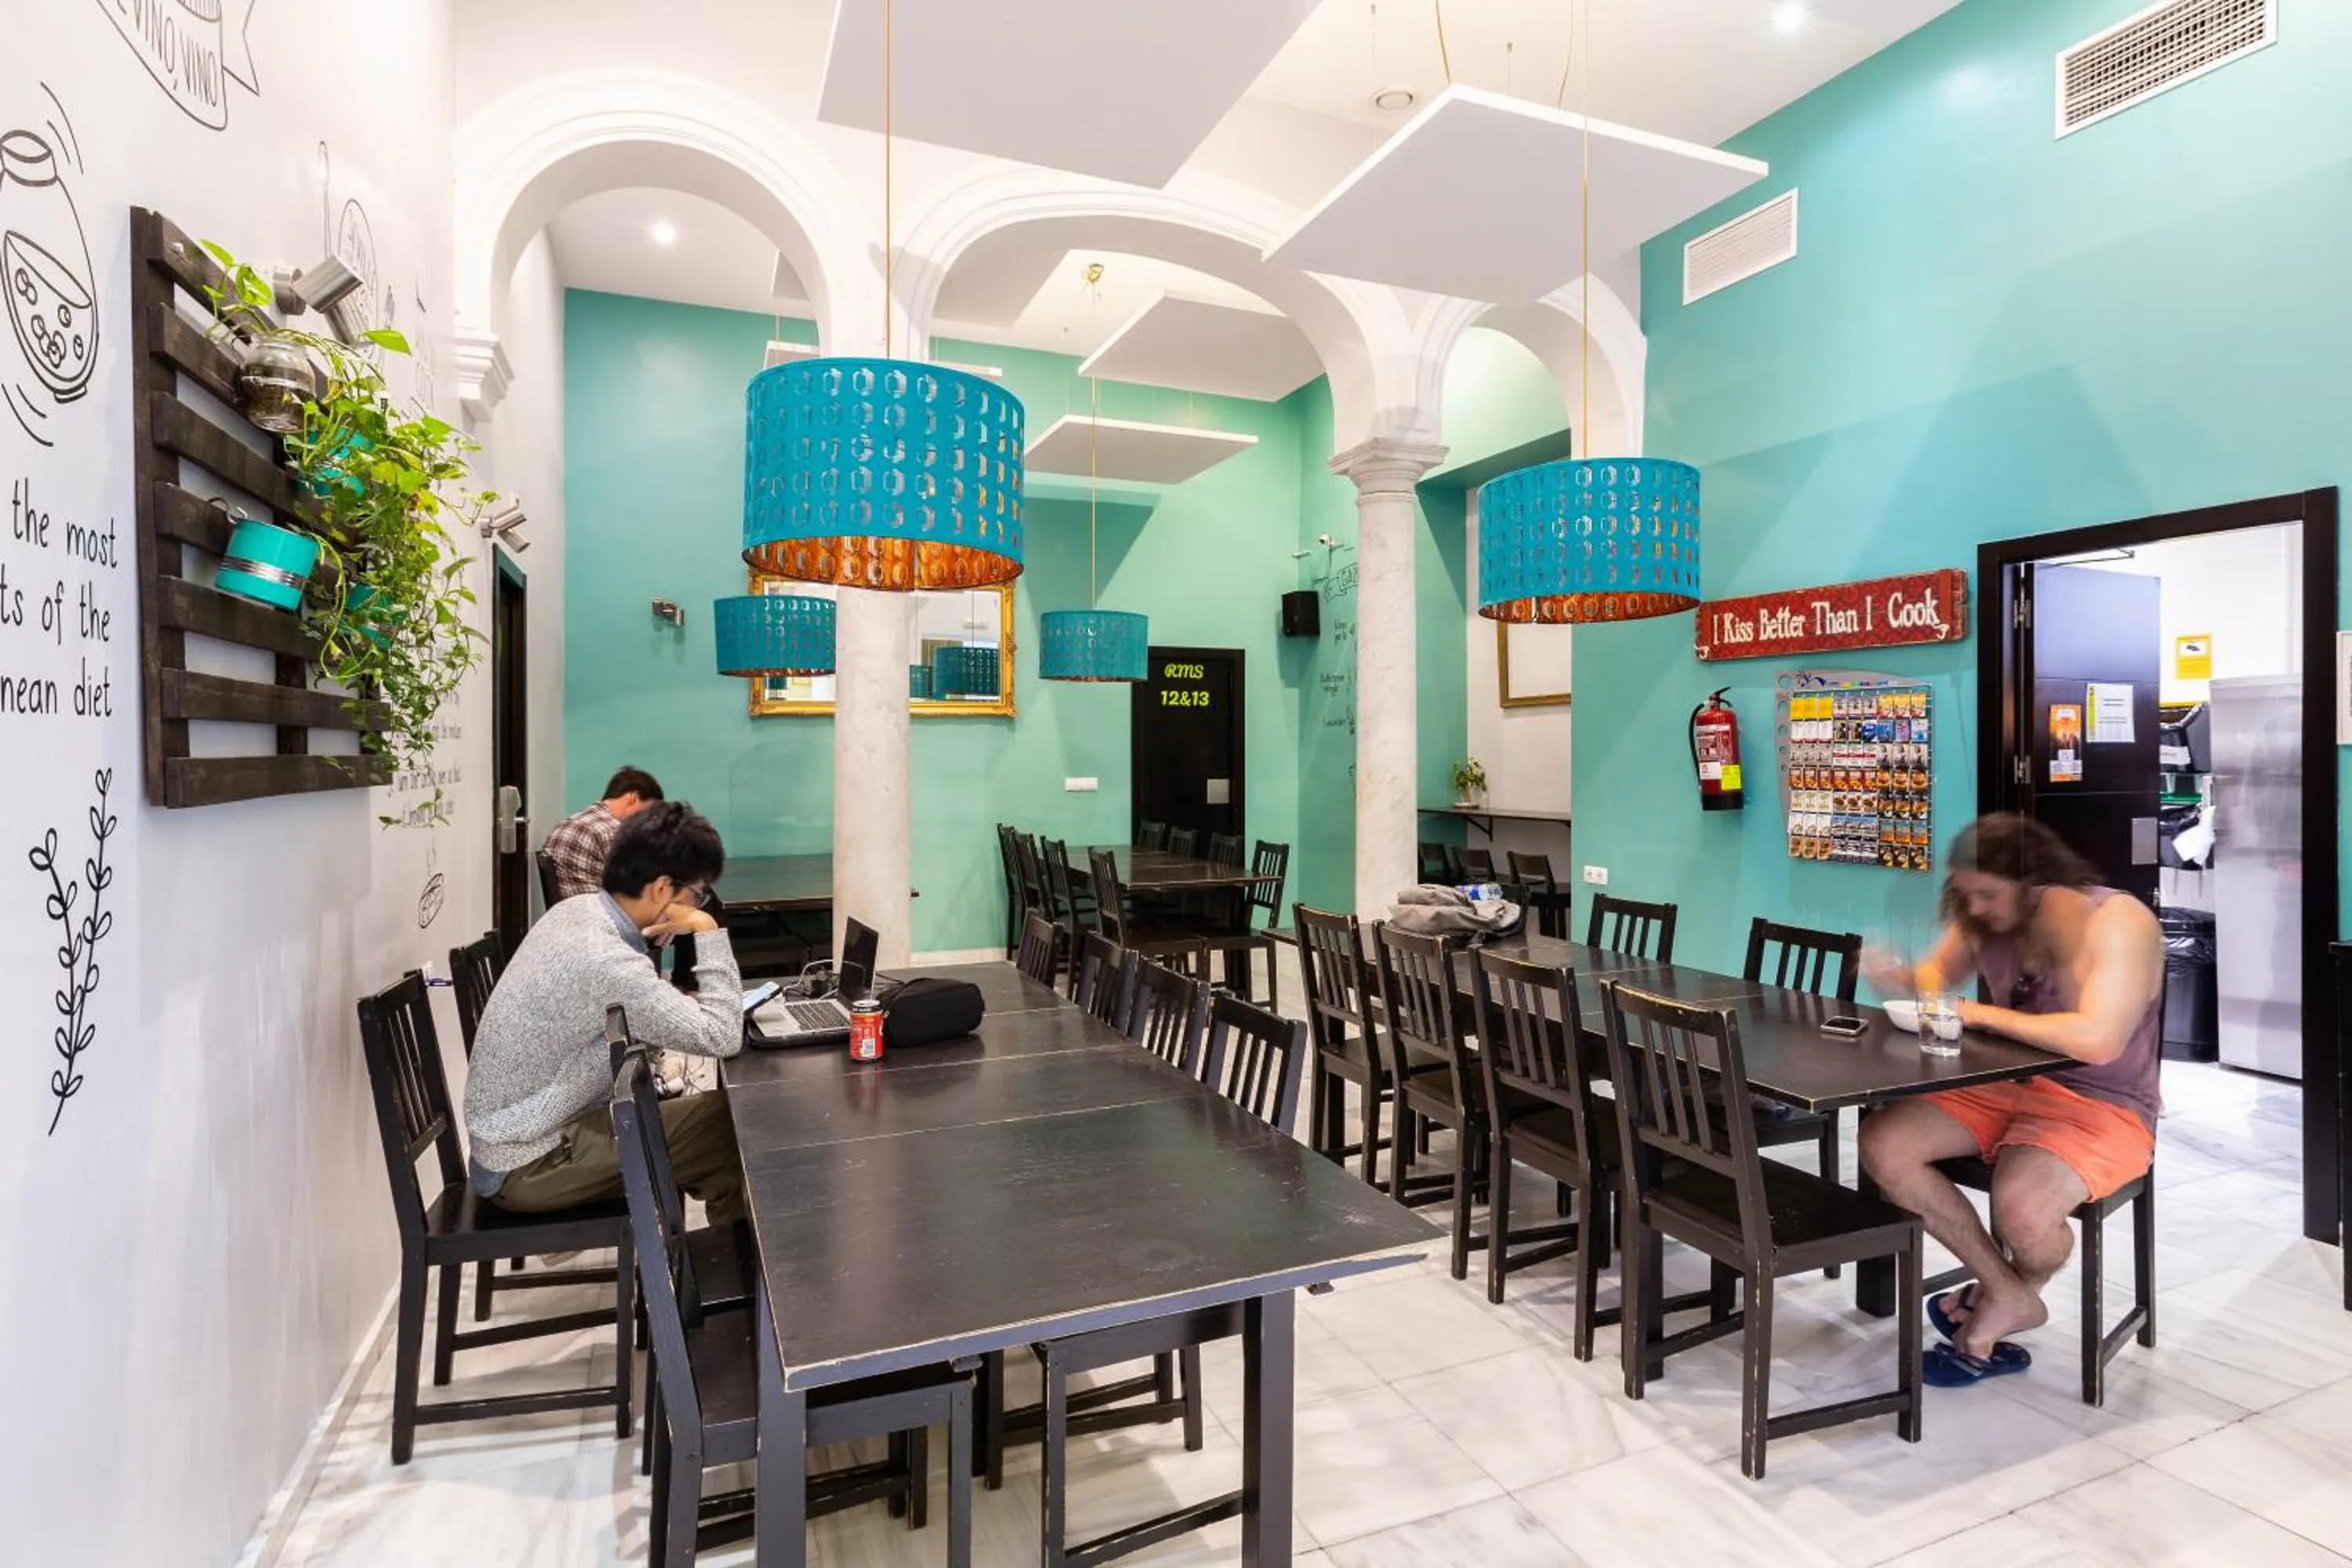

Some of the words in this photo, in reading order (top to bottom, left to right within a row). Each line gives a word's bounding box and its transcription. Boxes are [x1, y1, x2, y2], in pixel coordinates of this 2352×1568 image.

[180, 30, 217, 107] VINO
[12, 477, 49, 548] the
[66, 516, 118, 568] most
[42, 579, 64, 646] of
[79, 580, 111, 642] the
[1713, 614, 1719, 645] I
[1722, 612, 1754, 644] Kiss
[1759, 605, 1806, 641] Better
[1811, 601, 1860, 636] Than
[1865, 595, 1873, 631] I
[1887, 588, 1941, 628] Cook
[0, 674, 57, 715] nean
[74, 656, 112, 717] diet
[1160, 690, 1210, 706] 12&13
